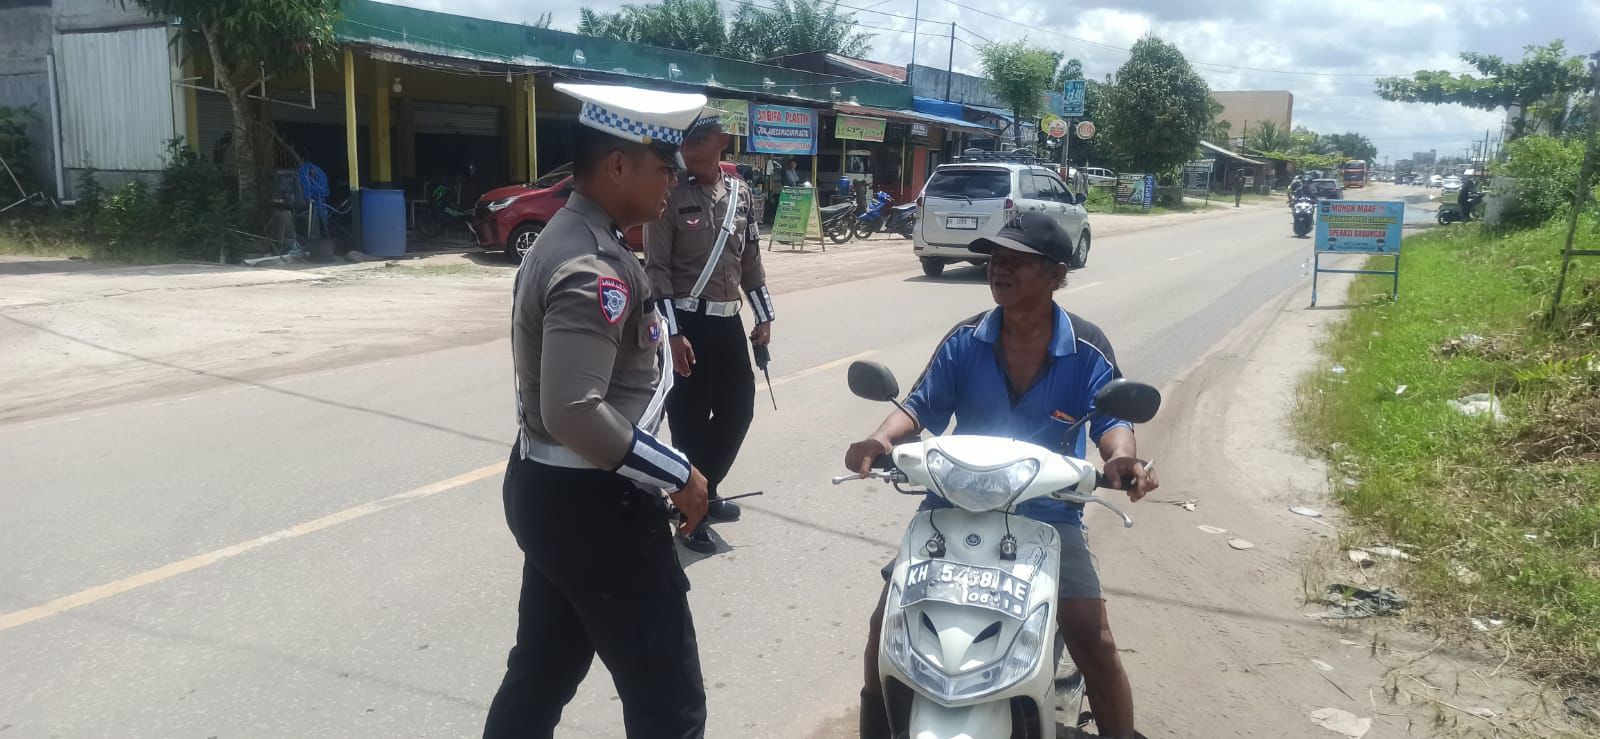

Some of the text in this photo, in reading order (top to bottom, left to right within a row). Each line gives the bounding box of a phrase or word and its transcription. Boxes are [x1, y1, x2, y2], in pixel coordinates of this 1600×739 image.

[785, 111, 810, 124] PLASTIK
[1331, 204, 1376, 213] MOHON MAAF
[907, 564, 929, 586] KH
[1003, 578, 1027, 601] AE
